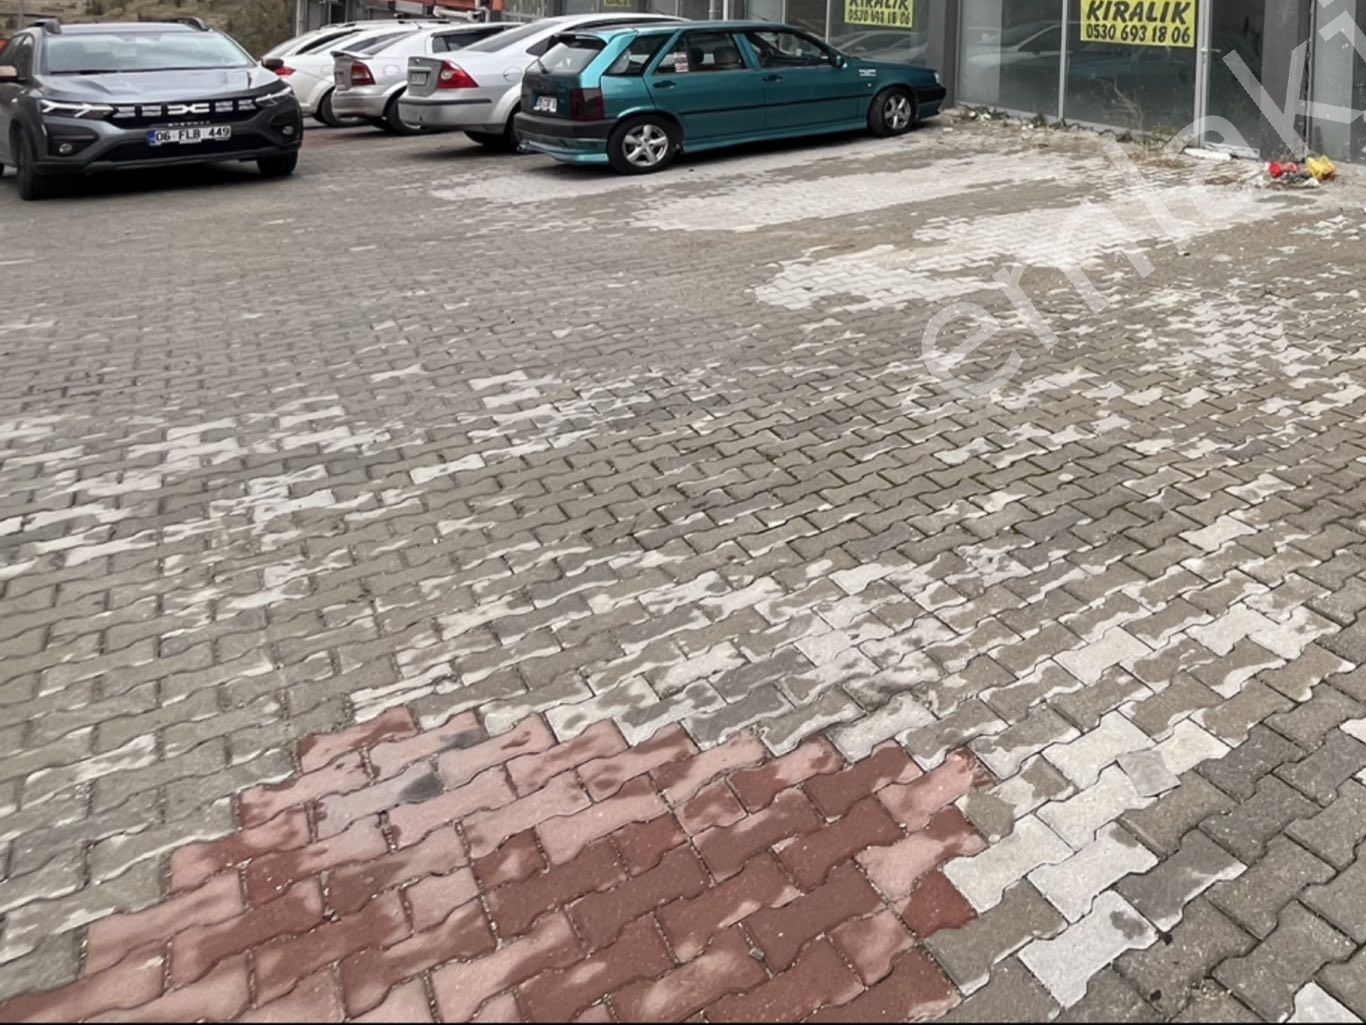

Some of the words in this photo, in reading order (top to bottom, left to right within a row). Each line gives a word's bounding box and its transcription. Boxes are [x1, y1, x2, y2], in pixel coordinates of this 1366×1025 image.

[1086, 23, 1117, 40] 0530
[1120, 24, 1147, 42] 693
[1152, 26, 1167, 43] 18
[1171, 26, 1190, 44] 06
